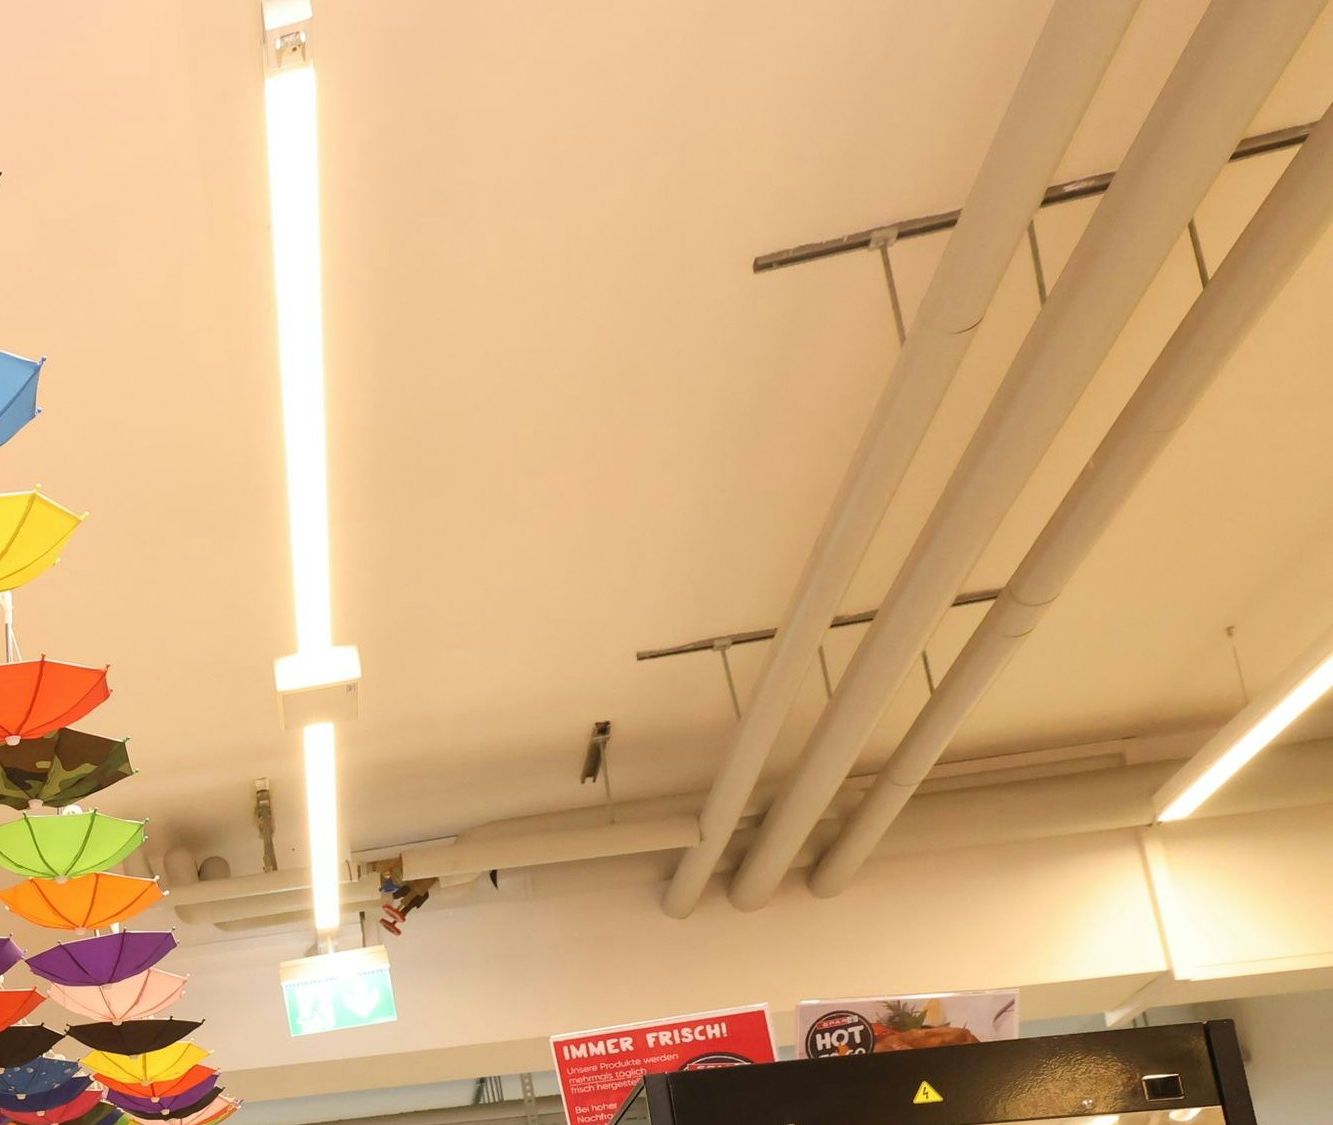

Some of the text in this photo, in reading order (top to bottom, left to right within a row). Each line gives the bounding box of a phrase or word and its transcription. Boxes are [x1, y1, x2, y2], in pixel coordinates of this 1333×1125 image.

[562, 1021, 729, 1061] IMMER FRISCH!
[815, 1025, 864, 1051] HOT
[566, 1053, 679, 1076] Unsere Produkte werden
[569, 1067, 647, 1084] mehrmals täglich
[570, 1083, 595, 1095] frisch
[575, 1101, 618, 1114] Bei hoher
[577, 1112, 614, 1123] Nachfra
